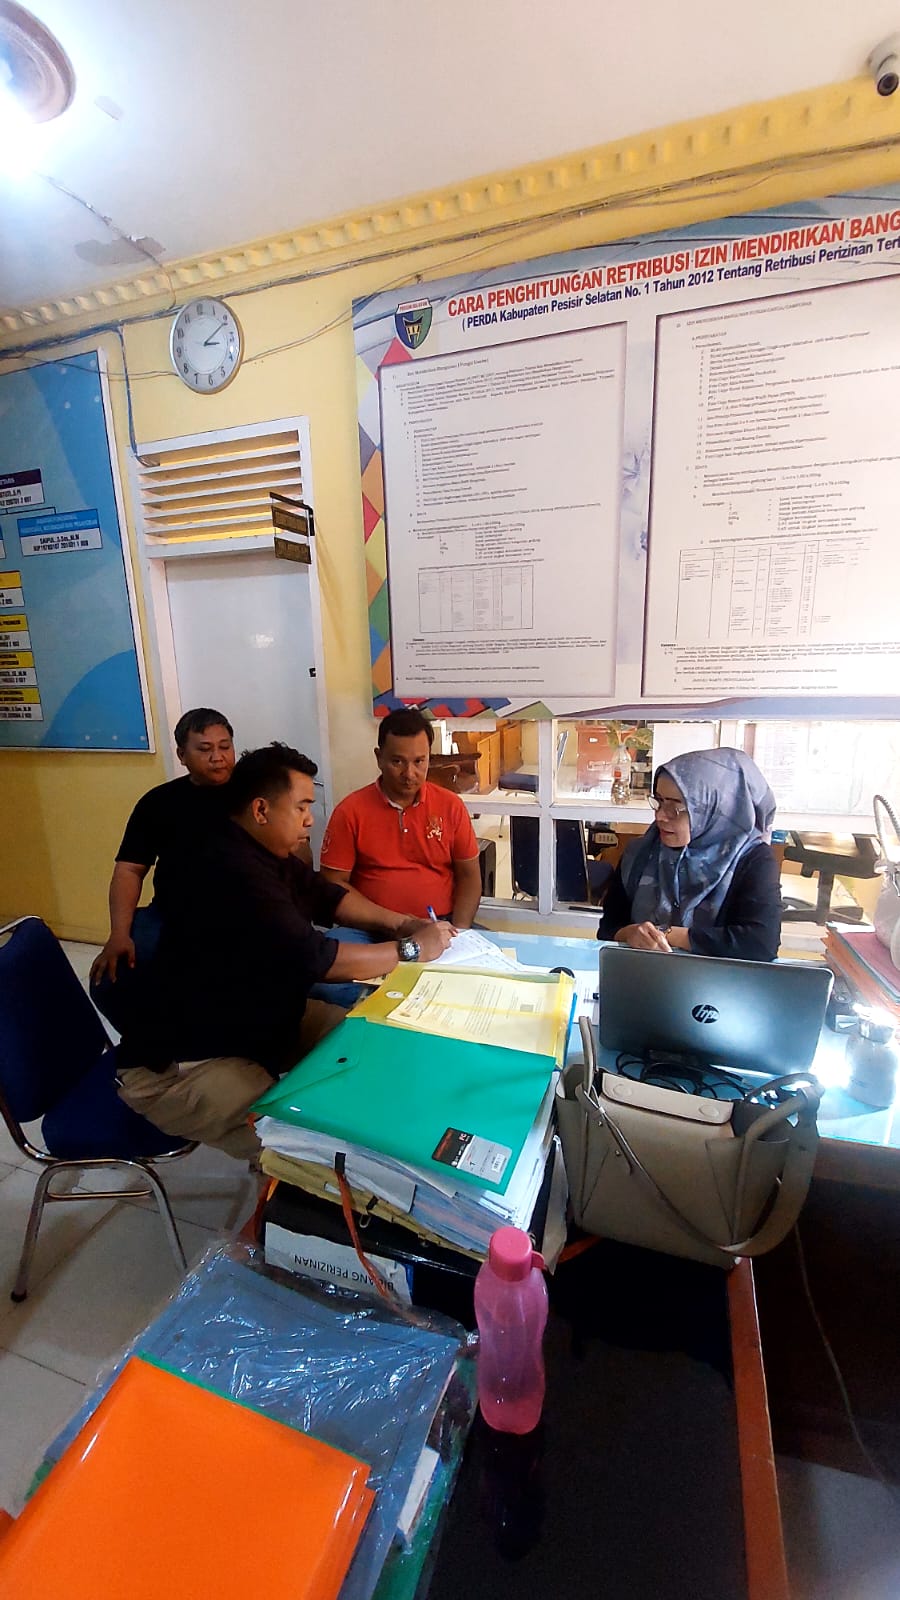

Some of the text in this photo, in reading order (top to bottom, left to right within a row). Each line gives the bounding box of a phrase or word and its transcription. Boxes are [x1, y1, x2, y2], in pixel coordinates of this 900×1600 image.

[448, 210, 900, 317] CARA PENGHITUNGAN RETRIBUSI IZIN MENDIRIKAN BANG
[467, 312, 498, 328] PERDA
[500, 306, 549, 322] Kabupaten
[551, 297, 583, 313] Pesisir
[585, 290, 622, 306] Selatan
[624, 285, 642, 298] No.
[644, 283, 650, 295] 1
[653, 277, 685, 293] Tahun
[688, 271, 714, 286] 2012
[717, 263, 762, 280] Tentang
[765, 252, 815, 273] Retribusi
[819, 244, 873, 264] Perizinan
[294, 1254, 349, 1280] PERIZINAN
